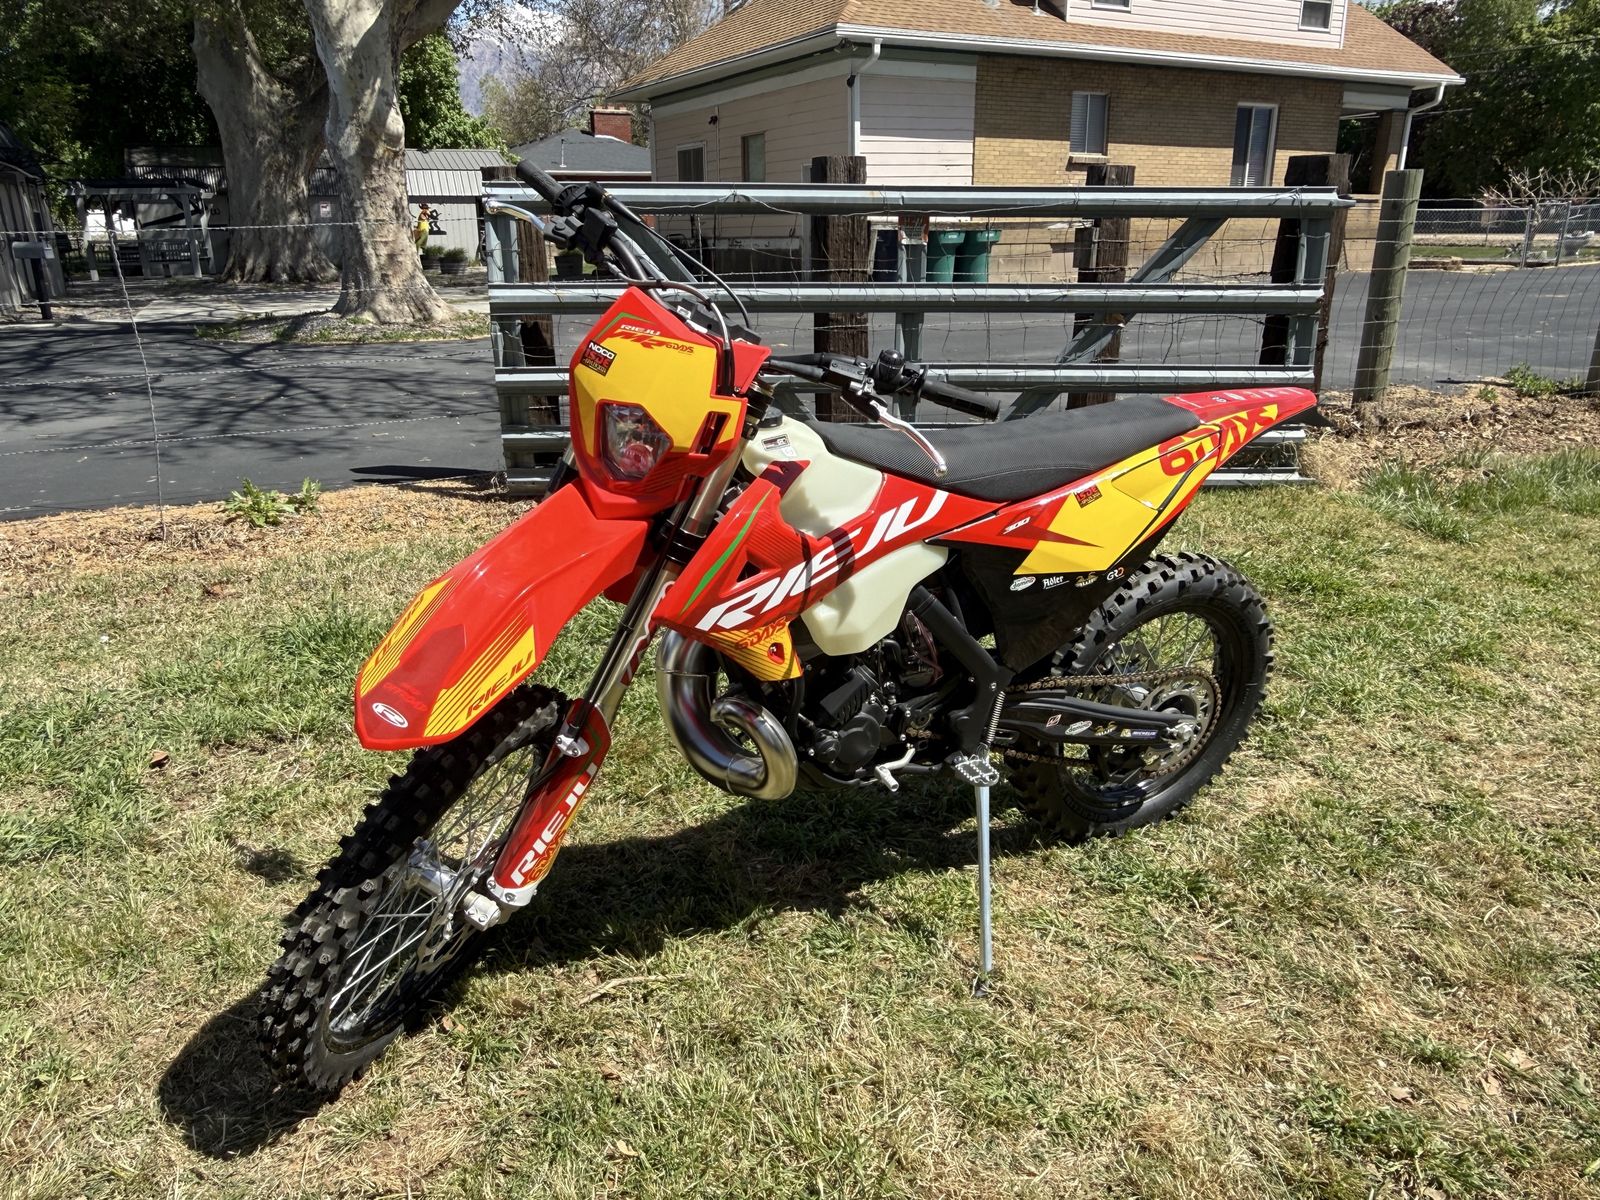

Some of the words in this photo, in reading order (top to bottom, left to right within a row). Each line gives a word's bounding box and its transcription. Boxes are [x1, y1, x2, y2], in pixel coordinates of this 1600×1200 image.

[588, 341, 616, 360] NOCO
[695, 489, 950, 632] RIEJU
[465, 650, 534, 718] RIEJU
[510, 761, 600, 886] RIEJU
